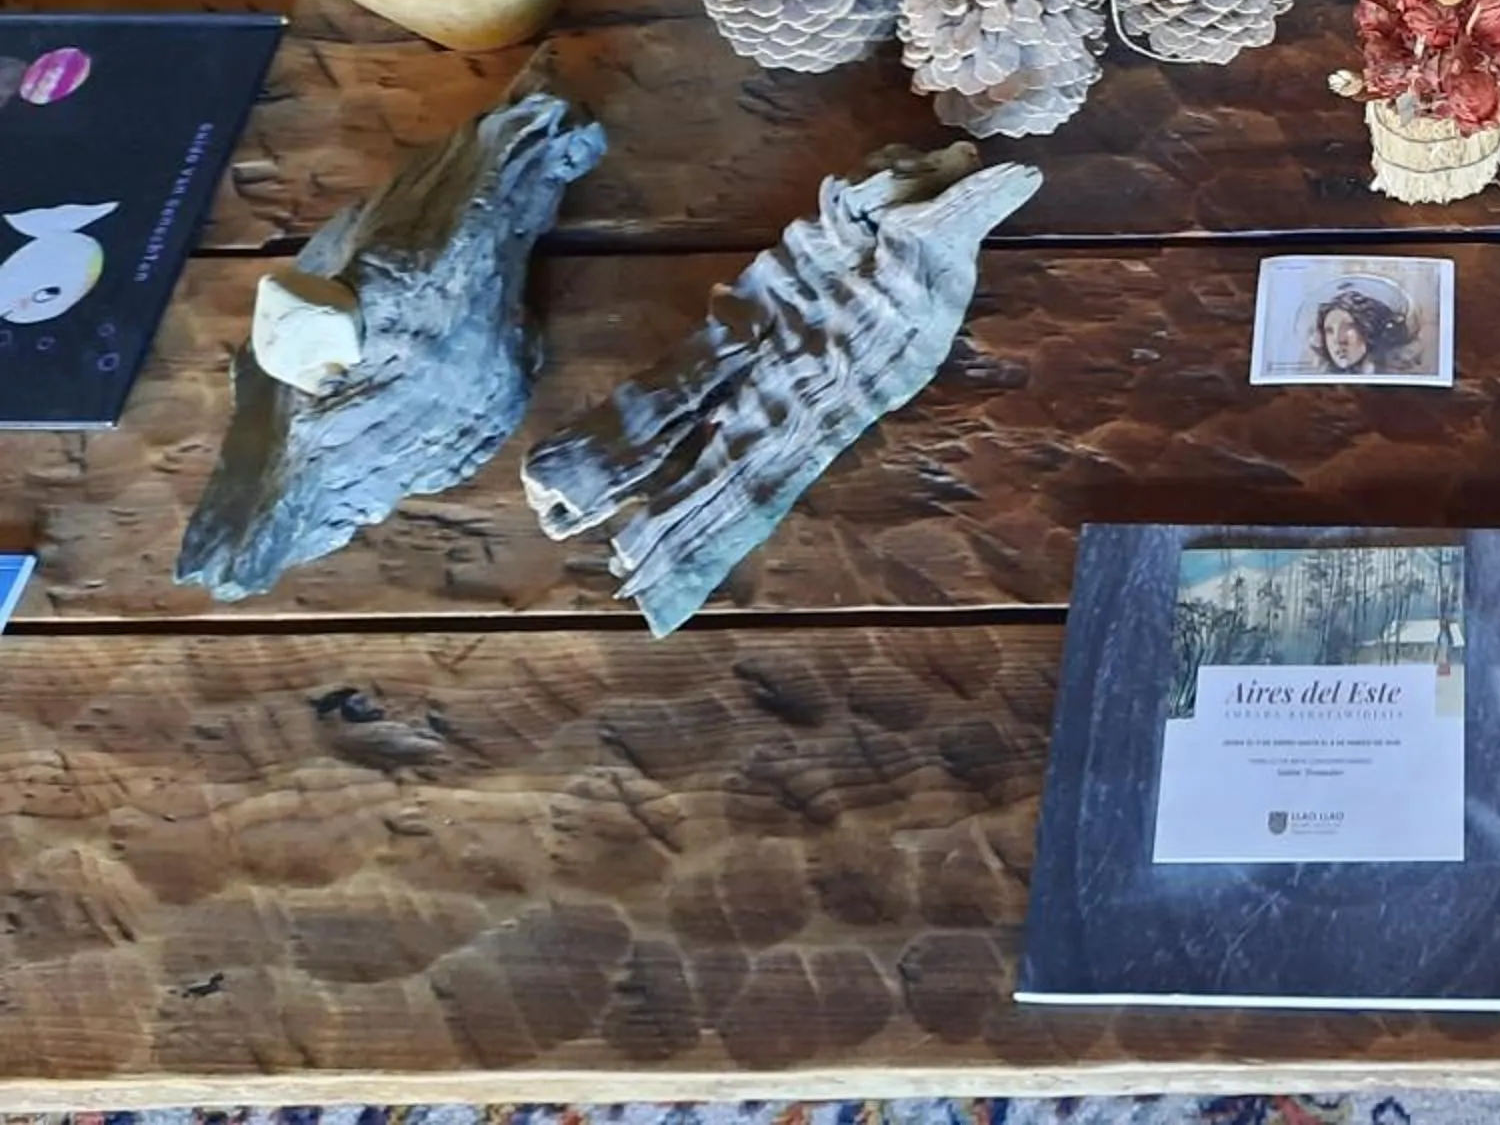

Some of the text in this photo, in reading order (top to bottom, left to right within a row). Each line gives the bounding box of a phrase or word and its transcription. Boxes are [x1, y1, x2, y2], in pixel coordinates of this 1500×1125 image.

[1225, 679, 1402, 705] Aires del Este
